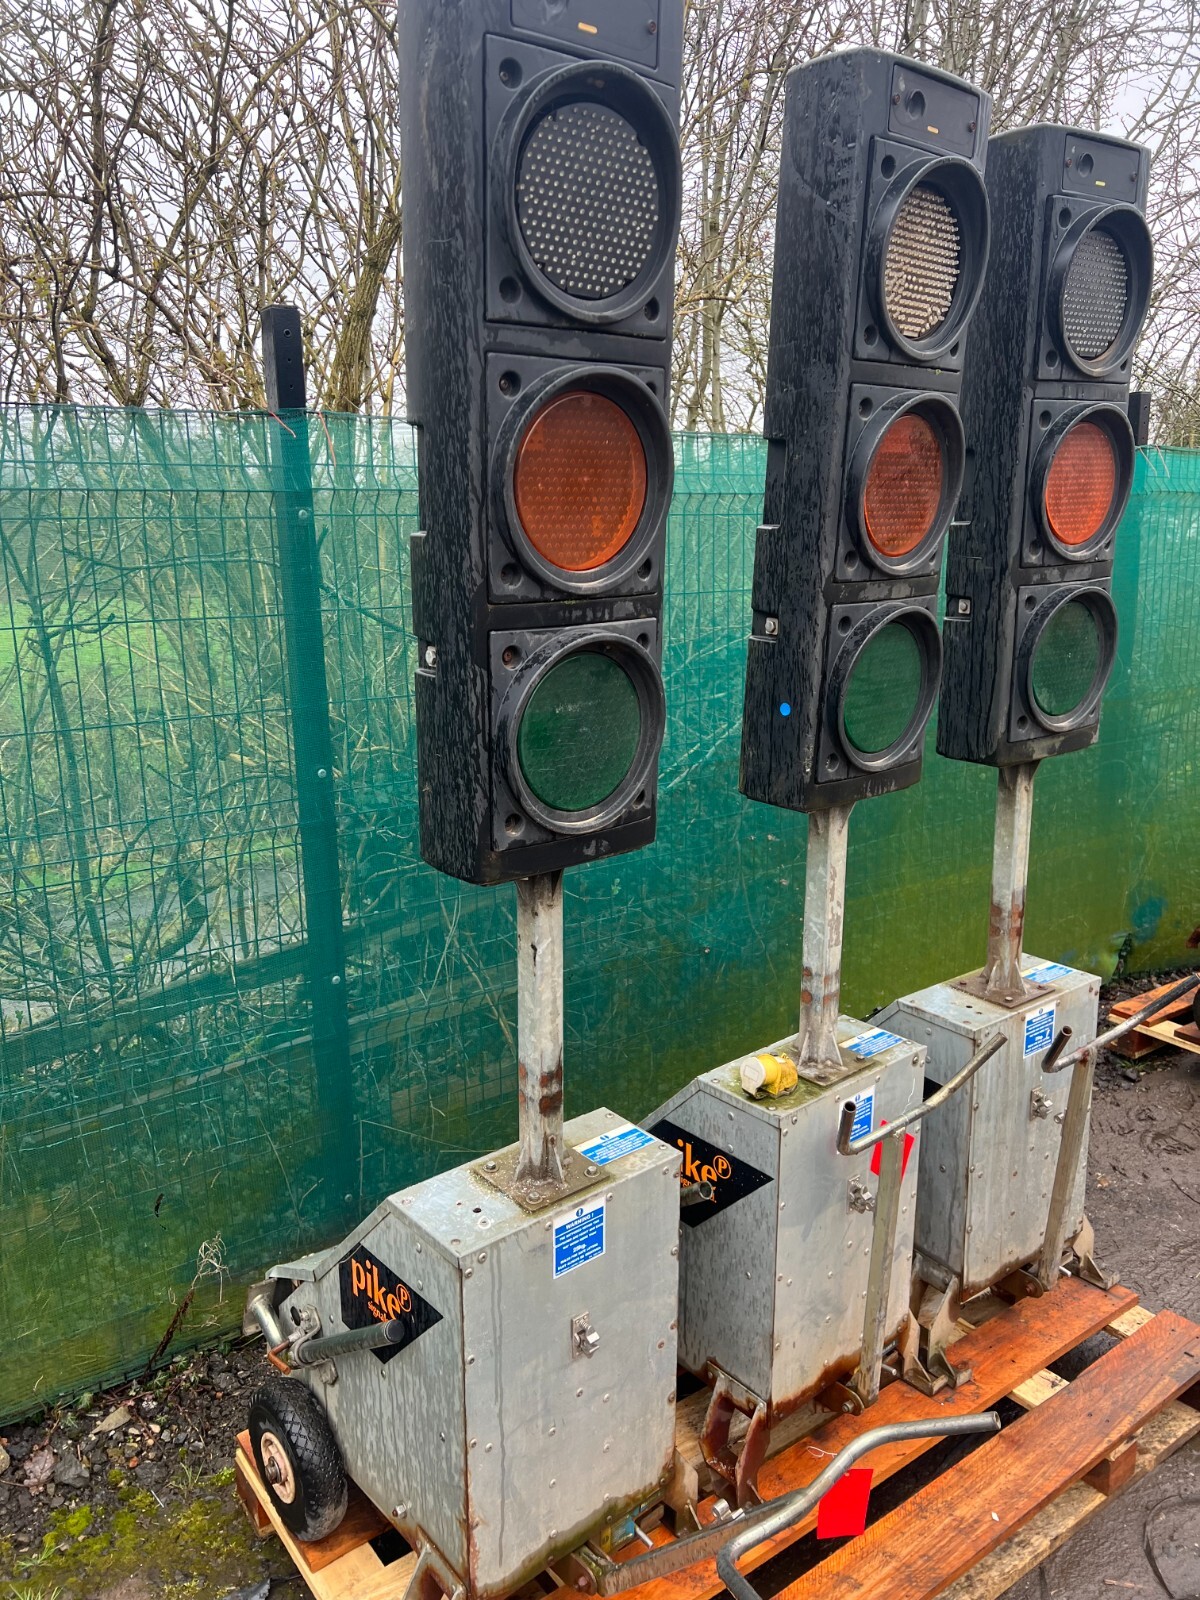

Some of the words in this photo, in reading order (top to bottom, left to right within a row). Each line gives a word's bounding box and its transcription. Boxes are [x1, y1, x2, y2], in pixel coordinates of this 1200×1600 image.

[677, 1139, 717, 1182] ke
[566, 1215, 591, 1229] WARNING
[351, 1258, 401, 1320] pike
